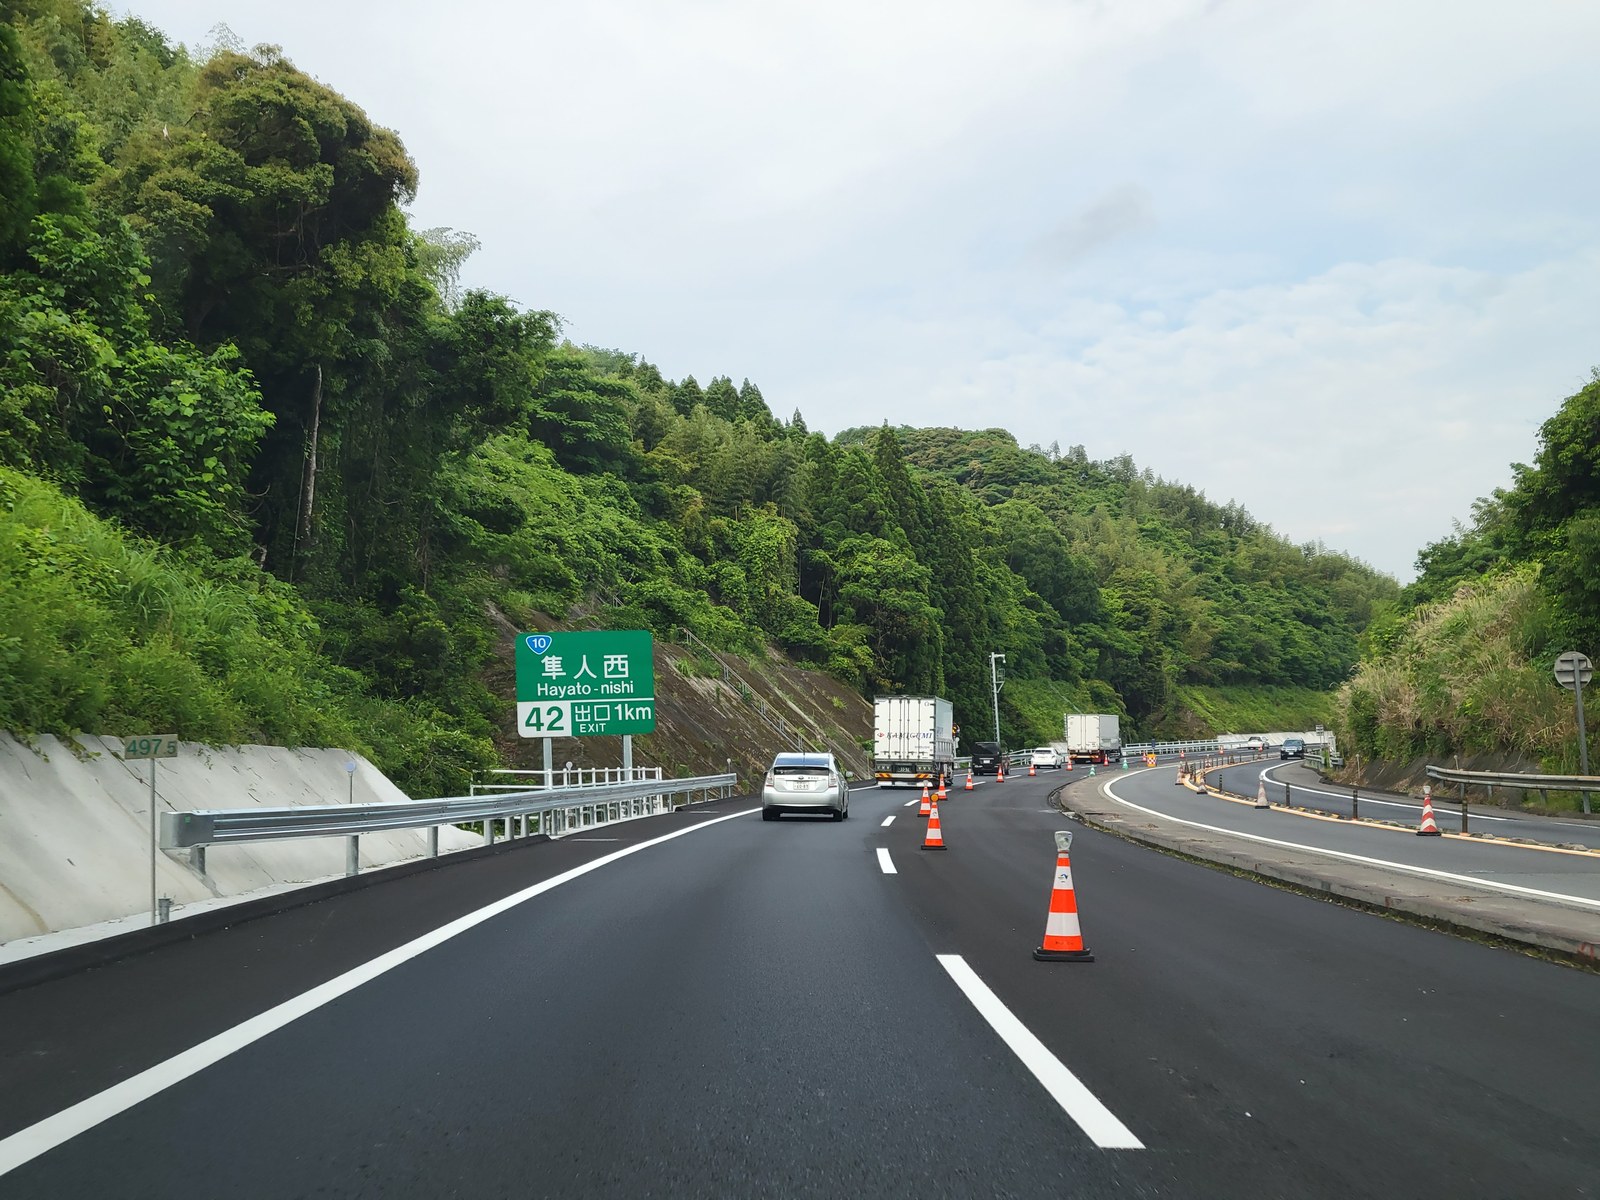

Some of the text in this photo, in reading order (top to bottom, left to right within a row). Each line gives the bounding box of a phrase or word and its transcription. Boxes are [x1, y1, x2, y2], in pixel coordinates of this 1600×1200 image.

[532, 637, 546, 649] 10
[541, 654, 629, 680] 隼人西
[524, 705, 565, 732] 42
[574, 703, 652, 722] 出口 1km
[579, 723, 606, 733] EXIT
